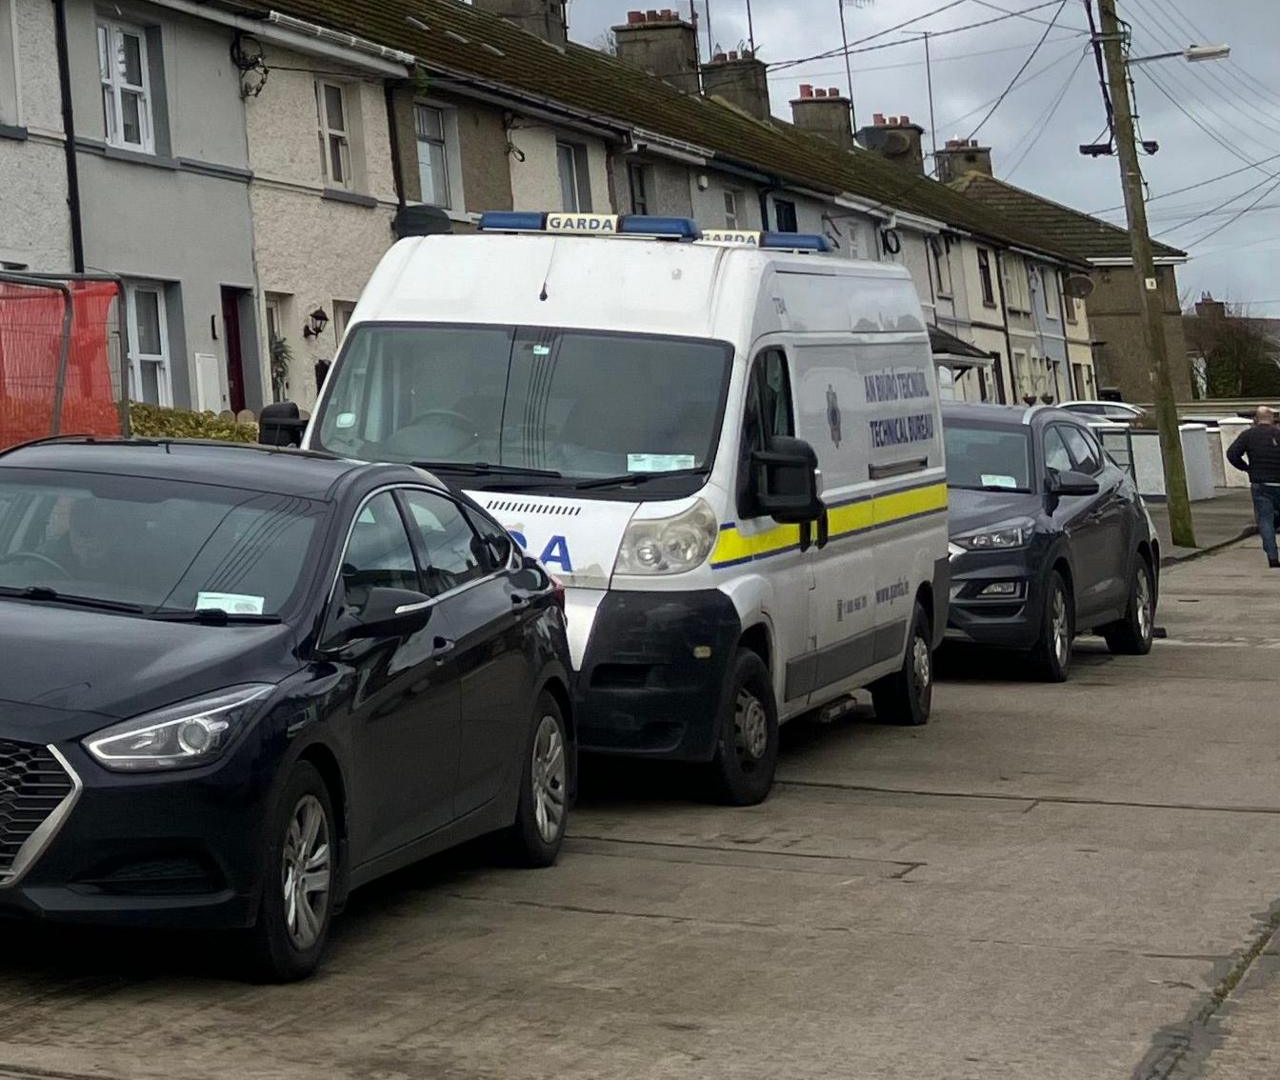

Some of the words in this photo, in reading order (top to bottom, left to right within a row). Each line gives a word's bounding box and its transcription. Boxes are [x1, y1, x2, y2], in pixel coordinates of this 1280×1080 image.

[549, 216, 614, 232] GARDA
[869, 417, 908, 447] TECHNICAL
[907, 413, 934, 442] BUREAU
